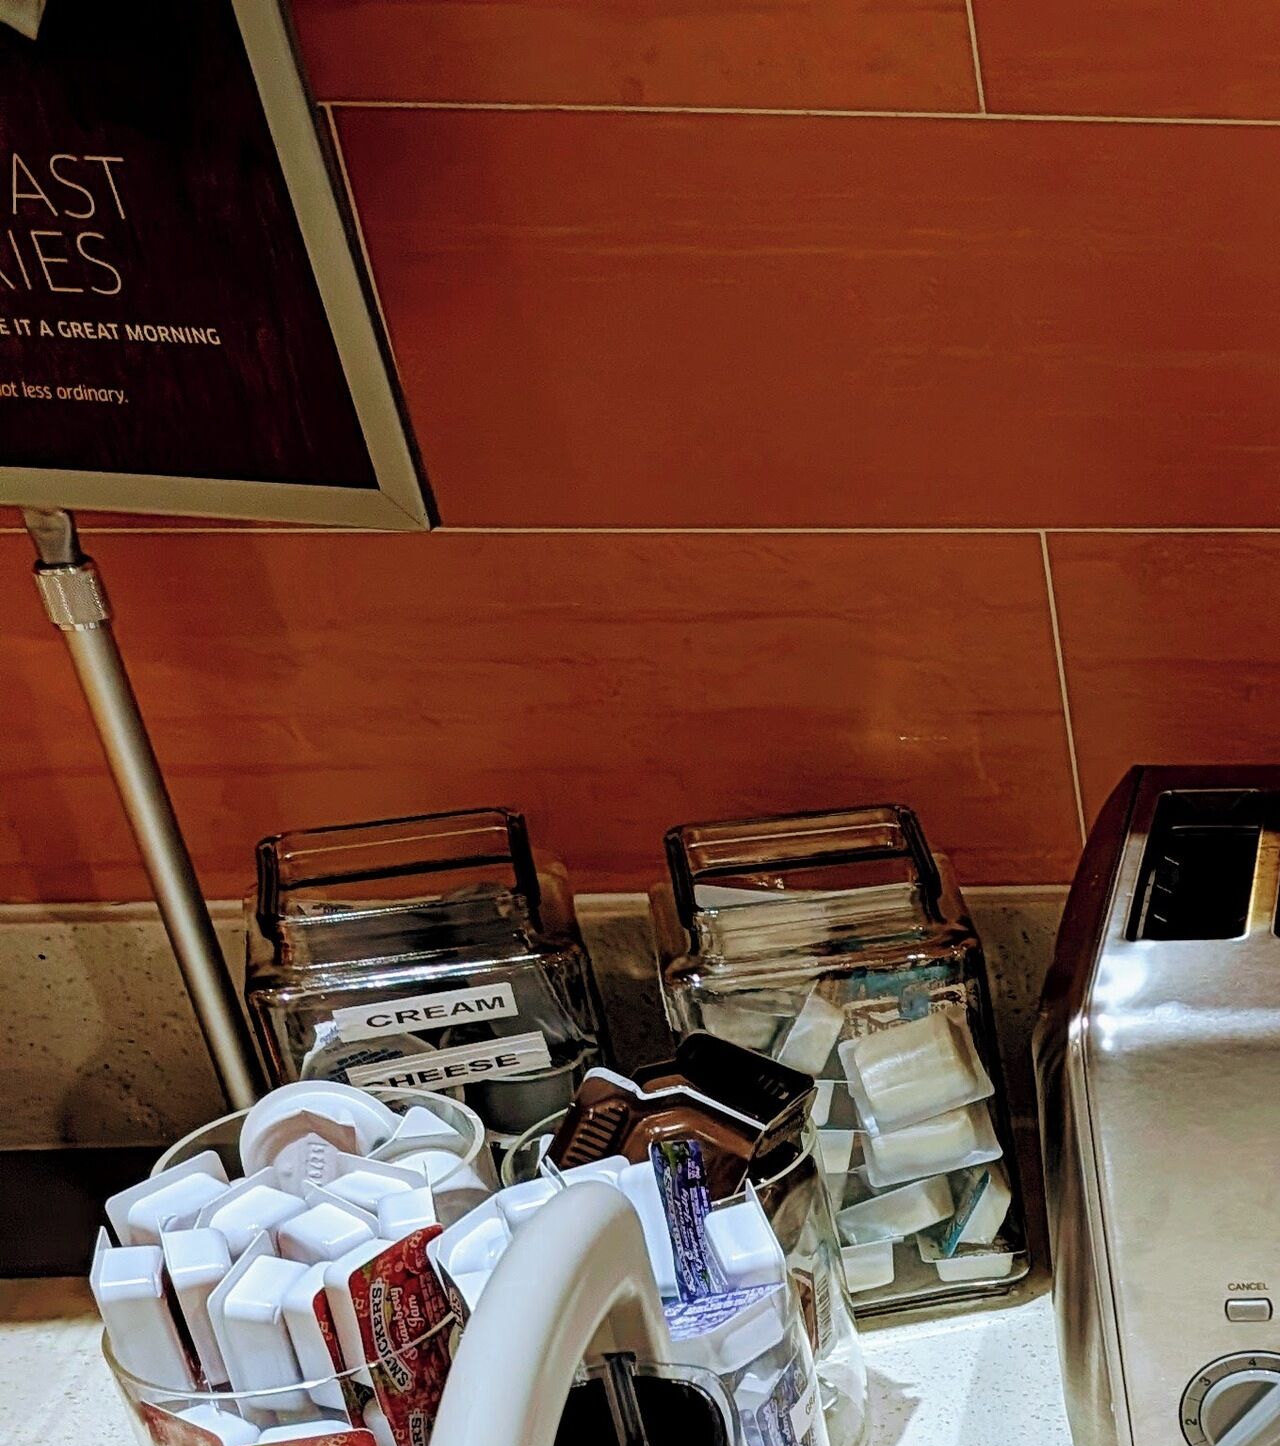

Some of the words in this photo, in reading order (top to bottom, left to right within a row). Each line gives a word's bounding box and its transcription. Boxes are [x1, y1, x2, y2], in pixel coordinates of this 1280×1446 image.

[12, 152, 126, 220] AST
[14, 317, 32, 337] IT
[39, 319, 55, 338] A
[57, 320, 121, 341] GREAT
[124, 323, 222, 346] MORNING
[21, 380, 53, 400] less
[56, 384, 129, 405] ordinary.
[366, 995, 506, 1029] CREAM
[1227, 1282, 1270, 1292] CANCEL
[1185, 1418, 1198, 1427] 2
[1199, 1376, 1212, 1388] 3
[1248, 1358, 1257, 1367] 4
